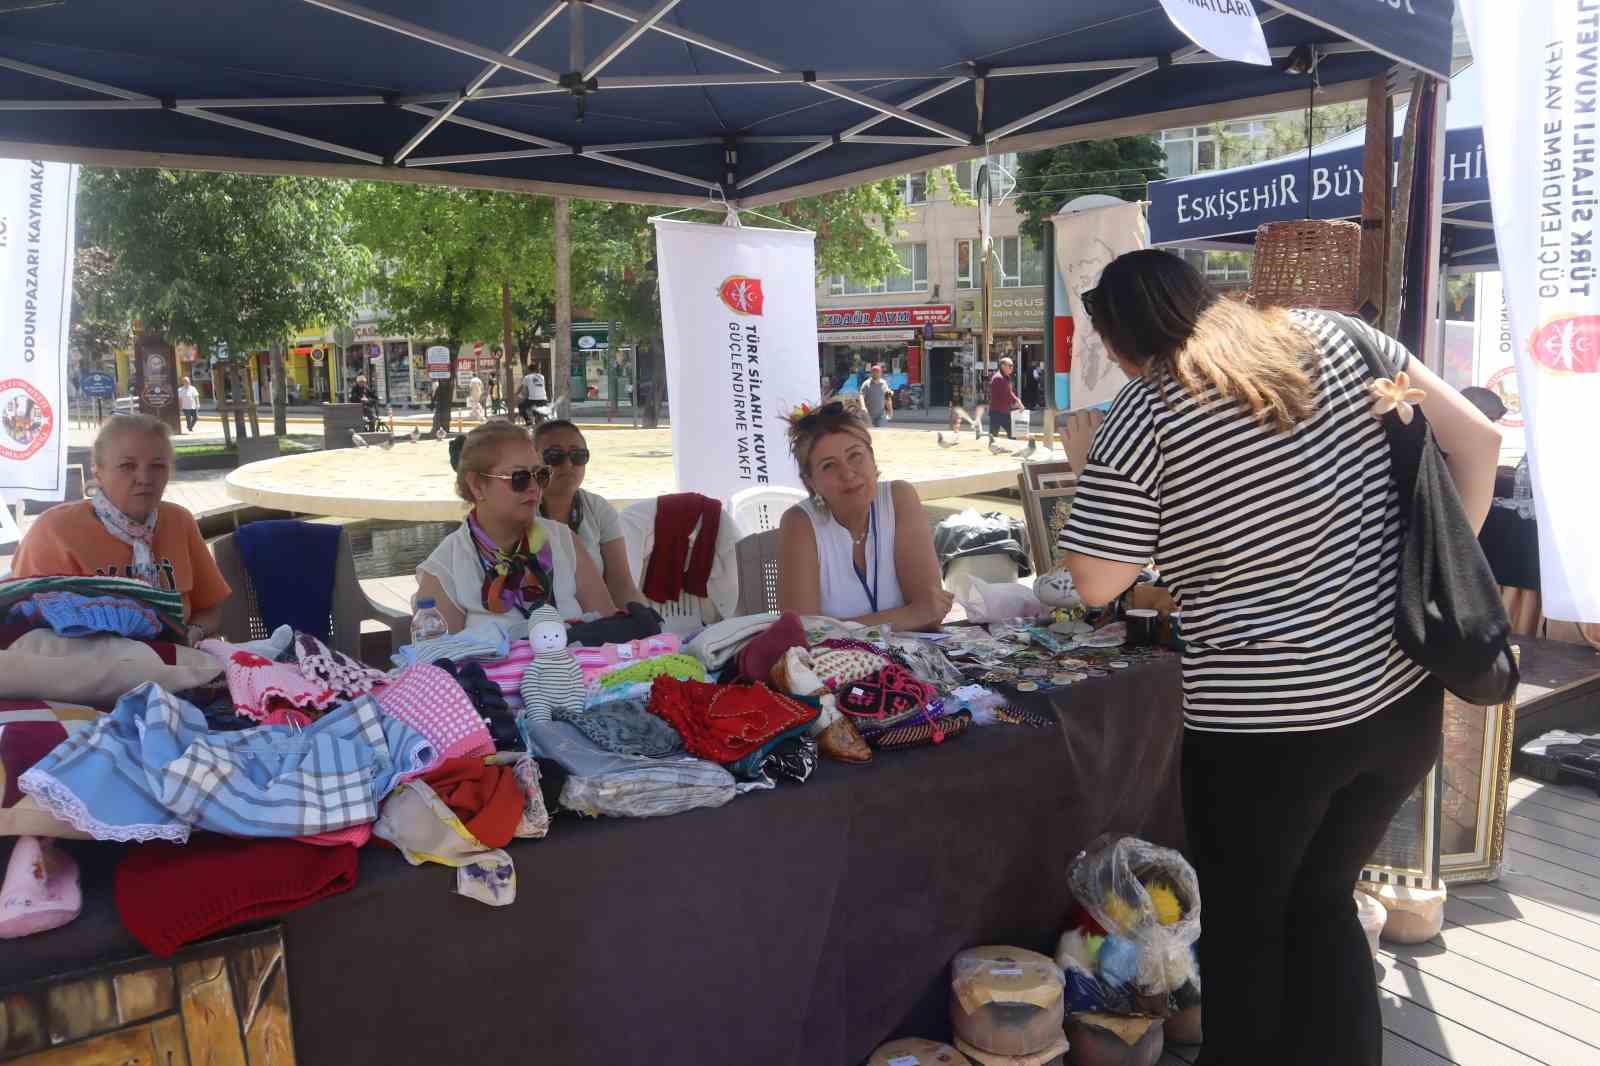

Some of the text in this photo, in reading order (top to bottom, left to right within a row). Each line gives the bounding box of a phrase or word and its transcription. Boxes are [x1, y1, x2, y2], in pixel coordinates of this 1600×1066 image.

[24, 248, 40, 363] ODUNPAZARI
[745, 325, 758, 364] TÜRK
[728, 321, 751, 481] GÜÇLENDİRME VAKFI
[748, 367, 764, 429] SİLAHLI
